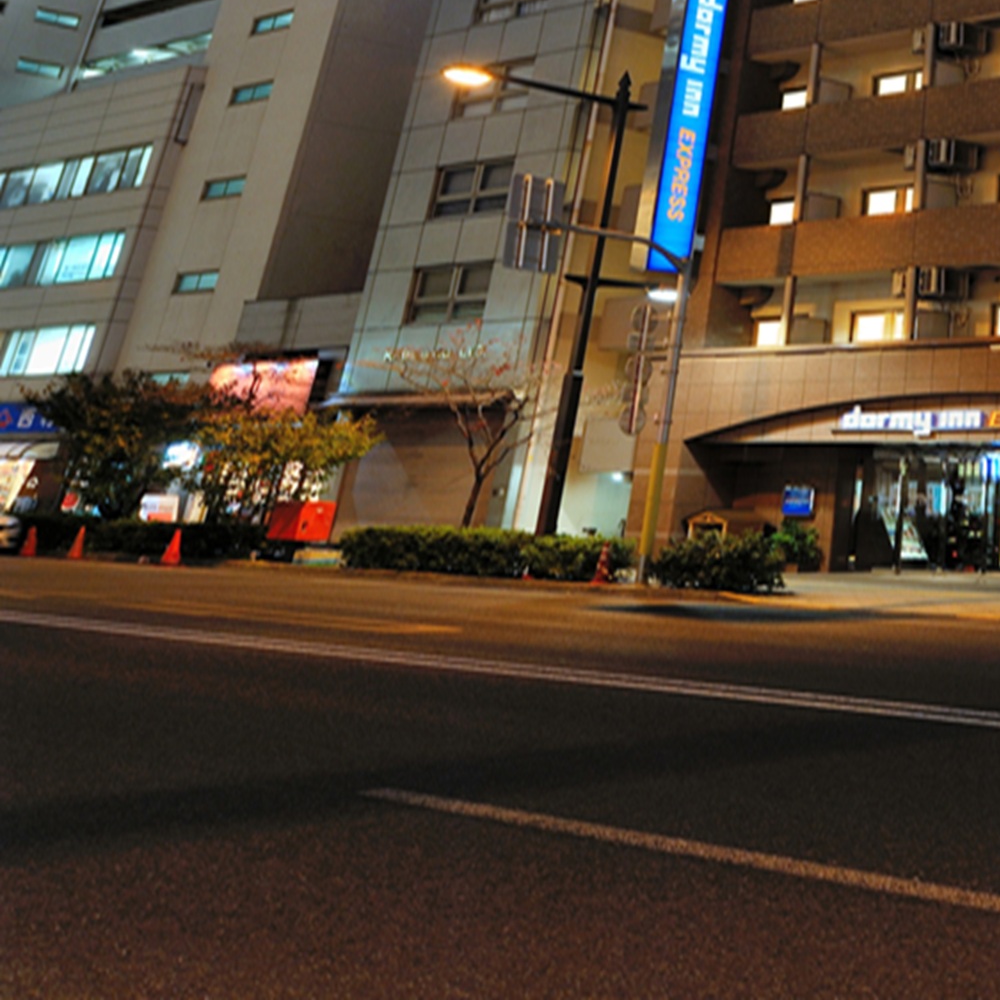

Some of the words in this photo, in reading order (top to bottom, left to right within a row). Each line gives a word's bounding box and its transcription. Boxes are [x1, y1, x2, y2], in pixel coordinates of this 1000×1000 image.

[682, 80, 704, 118] inn
[667, 127, 696, 222] EXPRESS
[839, 404, 933, 437] dormy
[937, 409, 982, 429] inn
